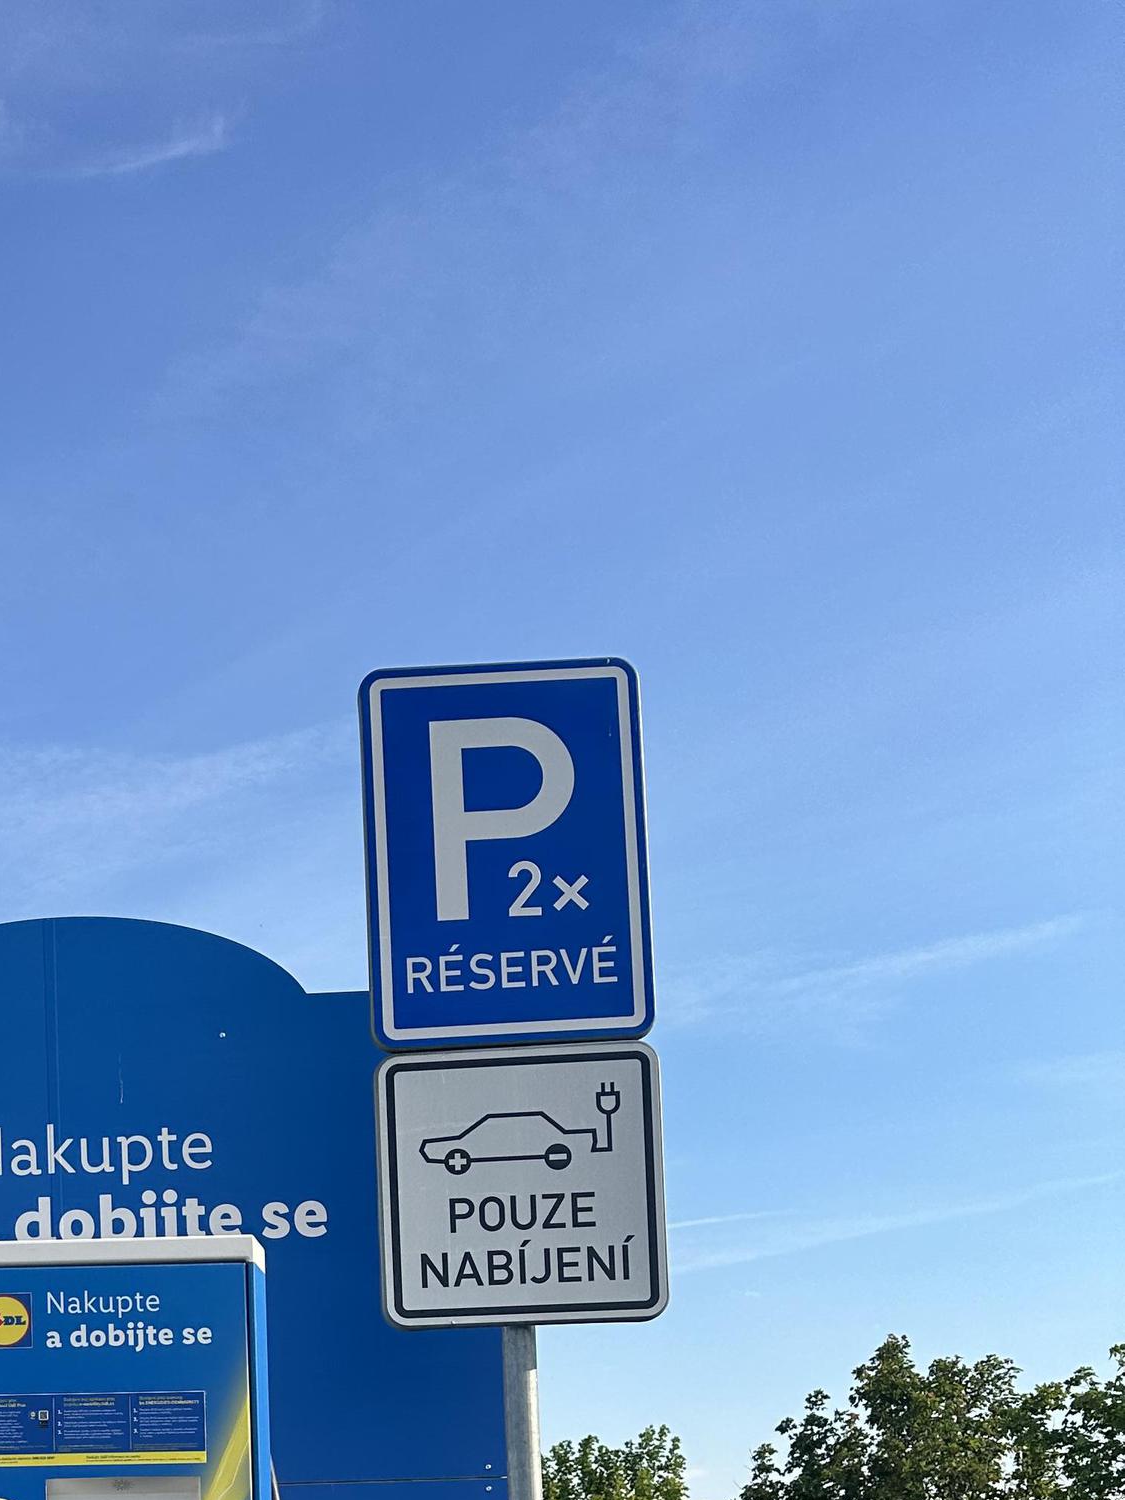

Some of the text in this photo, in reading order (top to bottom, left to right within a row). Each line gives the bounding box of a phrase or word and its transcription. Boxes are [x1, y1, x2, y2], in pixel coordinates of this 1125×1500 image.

[428, 716, 575, 923] P
[405, 935, 619, 995] RÉSERVÉ
[261, 1200, 329, 1240] se
[448, 1190, 597, 1234] POUZE
[420, 1234, 635, 1289] NABÍJENÍ
[46, 1290, 161, 1319] Nakupte
[45, 1321, 214, 1353] a dobijte se
